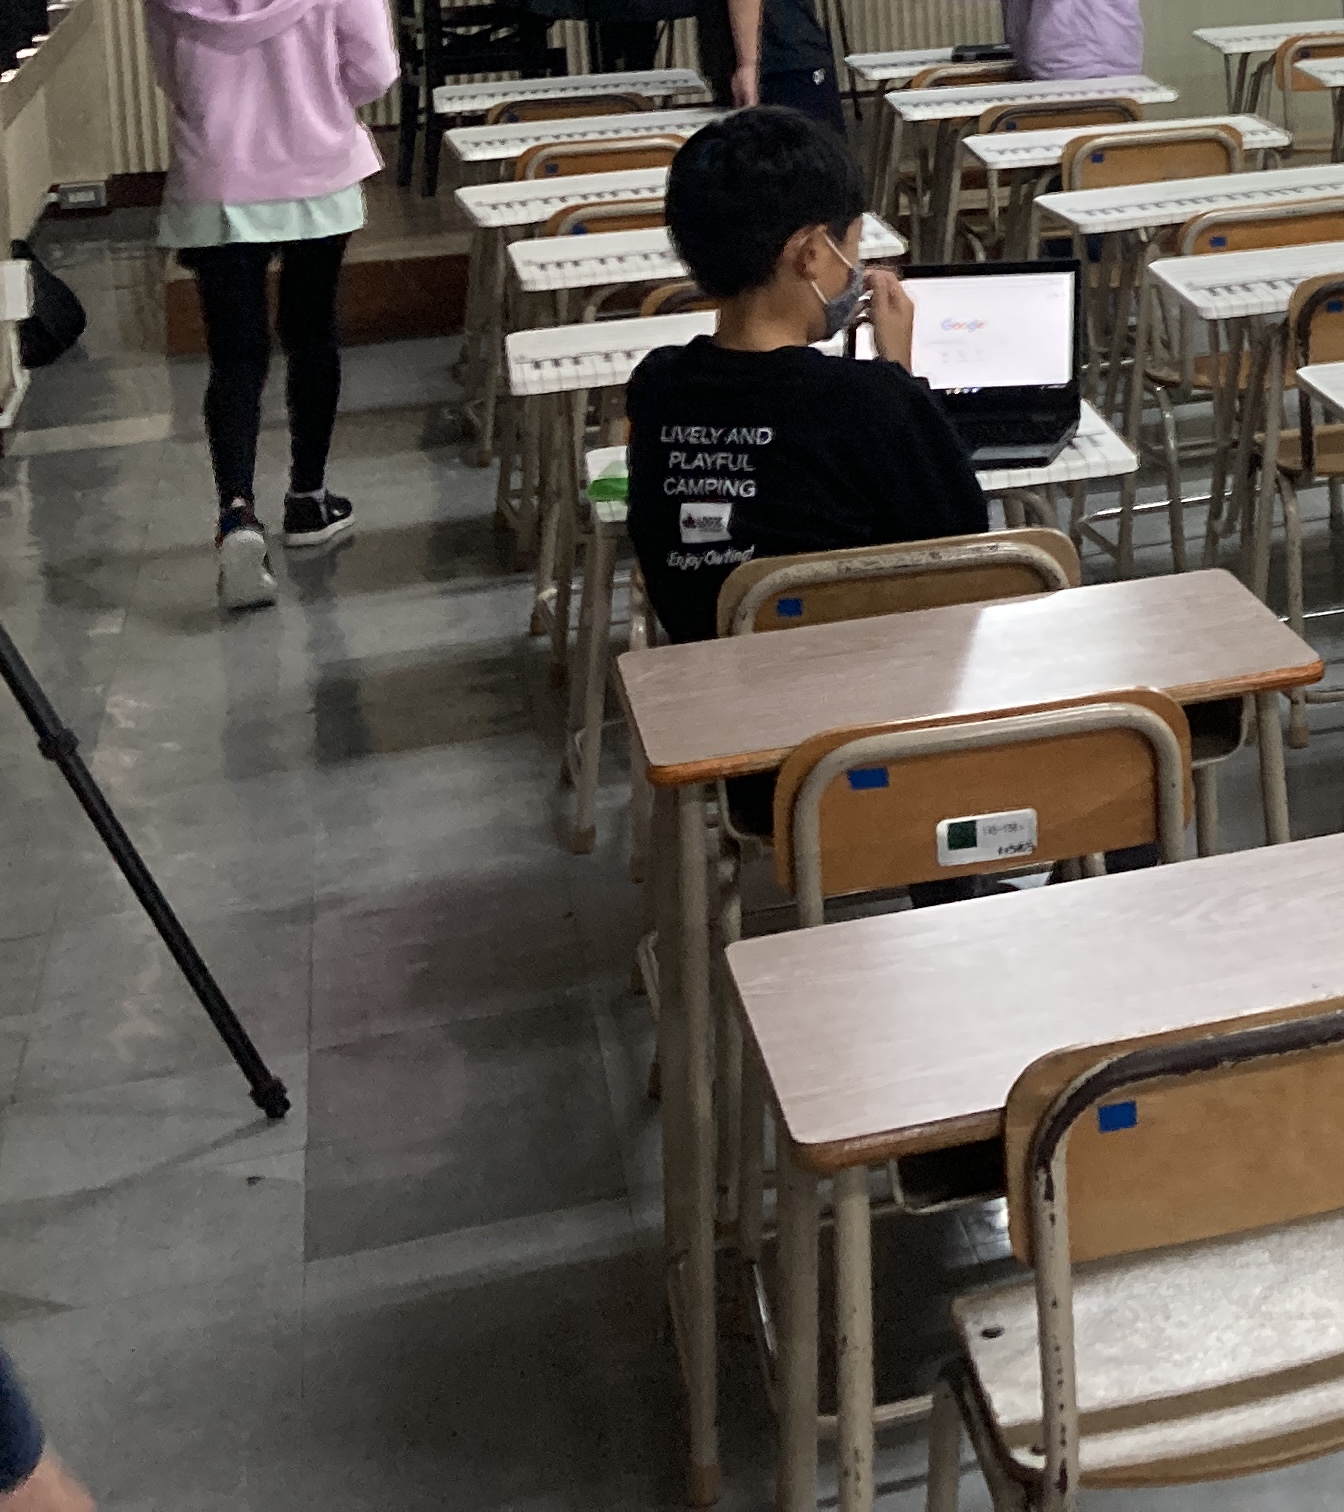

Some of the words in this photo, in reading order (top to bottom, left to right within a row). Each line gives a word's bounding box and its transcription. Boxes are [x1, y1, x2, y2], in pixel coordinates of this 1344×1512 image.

[940, 318, 988, 332] Google
[660, 424, 724, 445] LIVELY
[724, 426, 775, 445] AND
[668, 451, 756, 472] PLAYFUL
[663, 477, 757, 498] CAMPING
